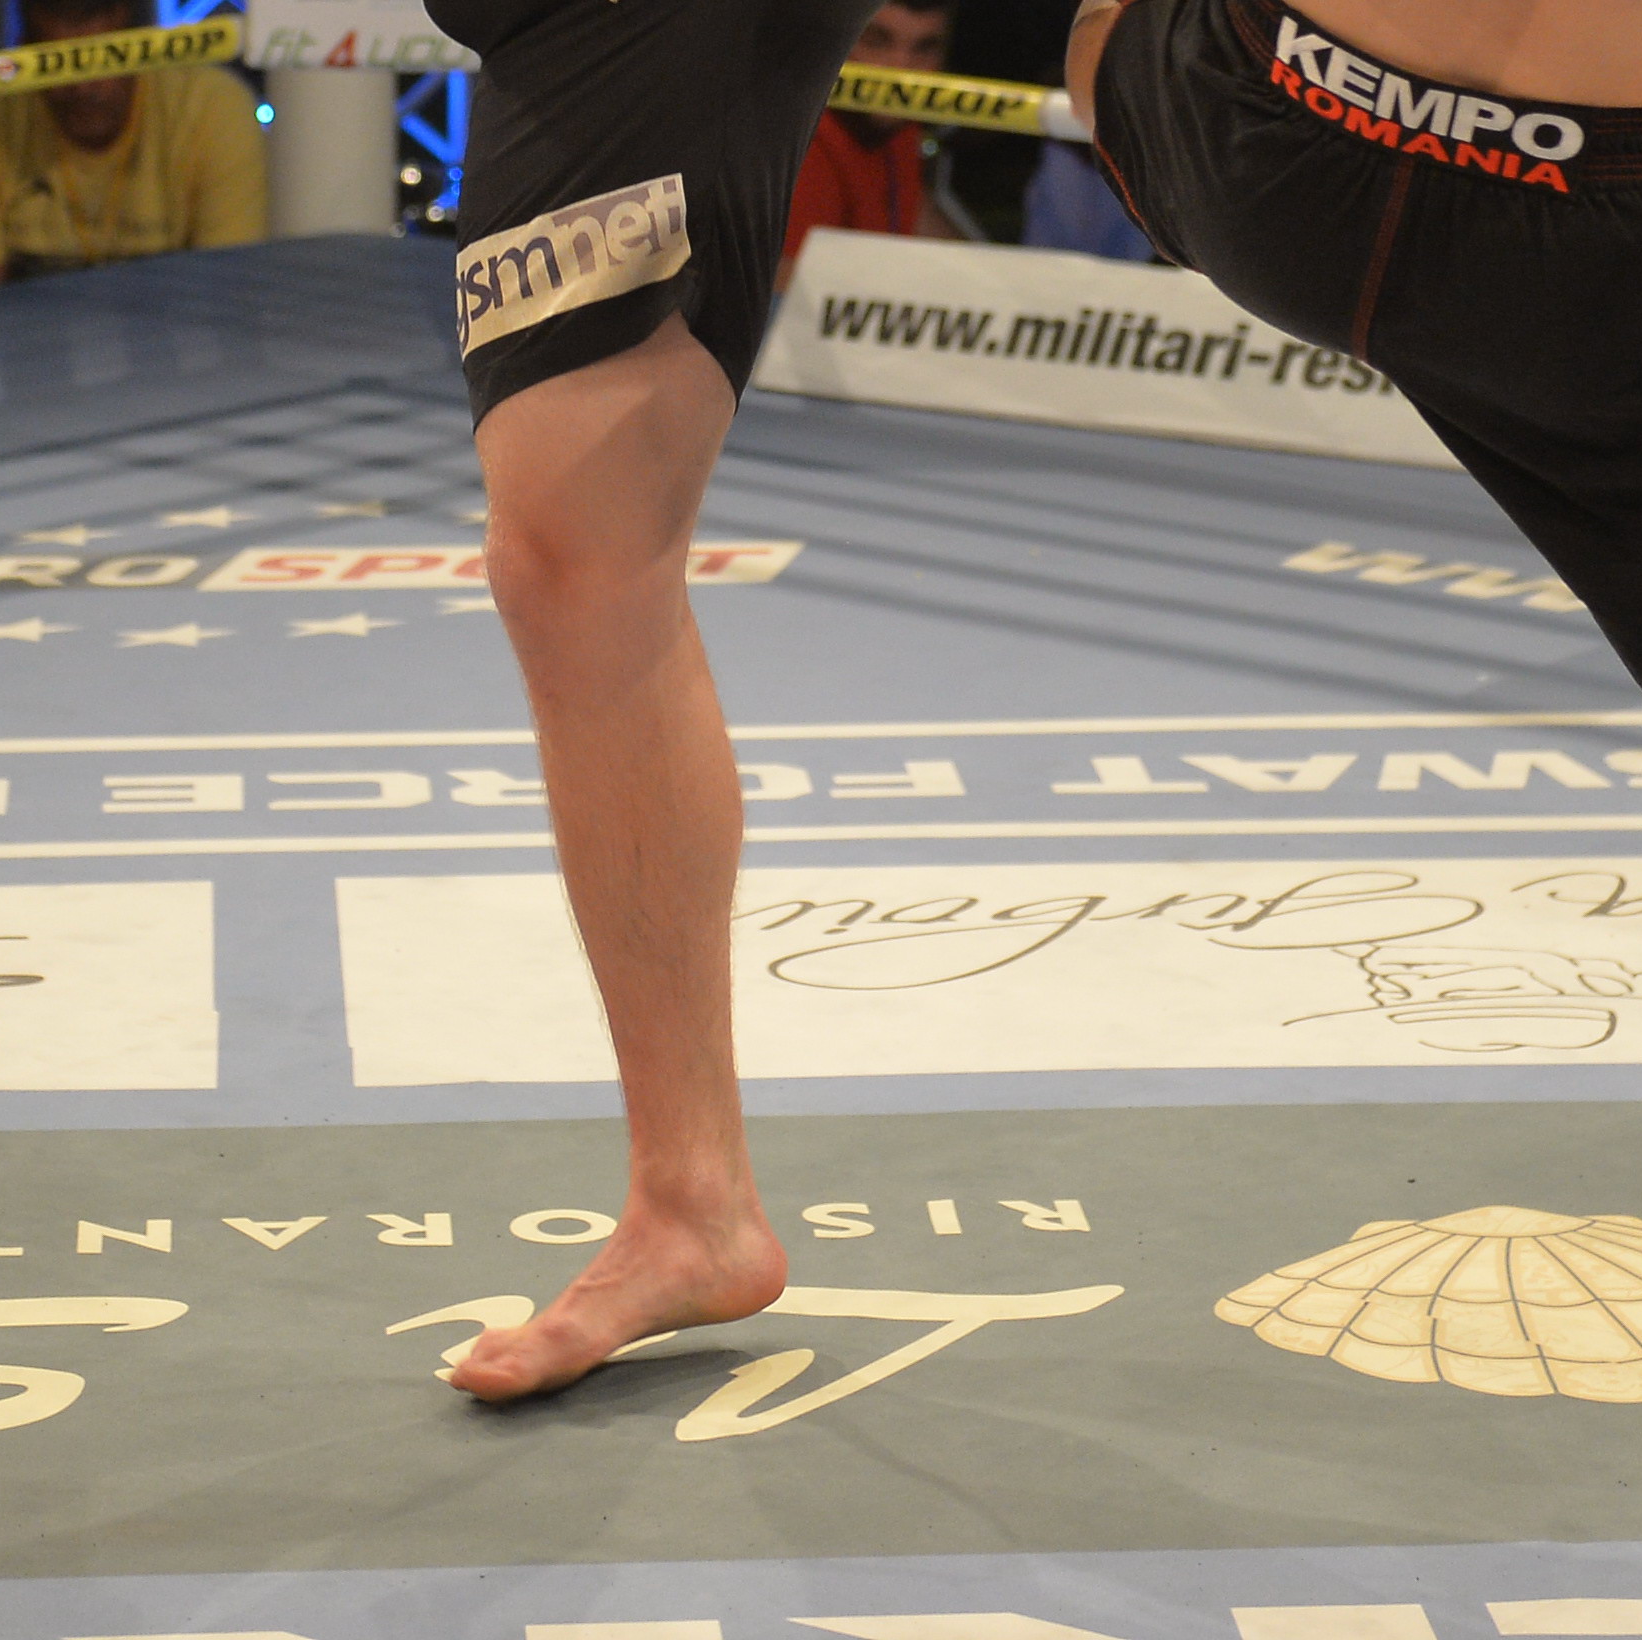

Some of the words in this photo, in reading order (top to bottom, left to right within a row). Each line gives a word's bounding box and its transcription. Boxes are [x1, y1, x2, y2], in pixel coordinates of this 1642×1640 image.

[34, 20, 230, 79] DUNLOP
[1275, 15, 1585, 161] KEMPO
[1268, 58, 1570, 194] ROMANIA
